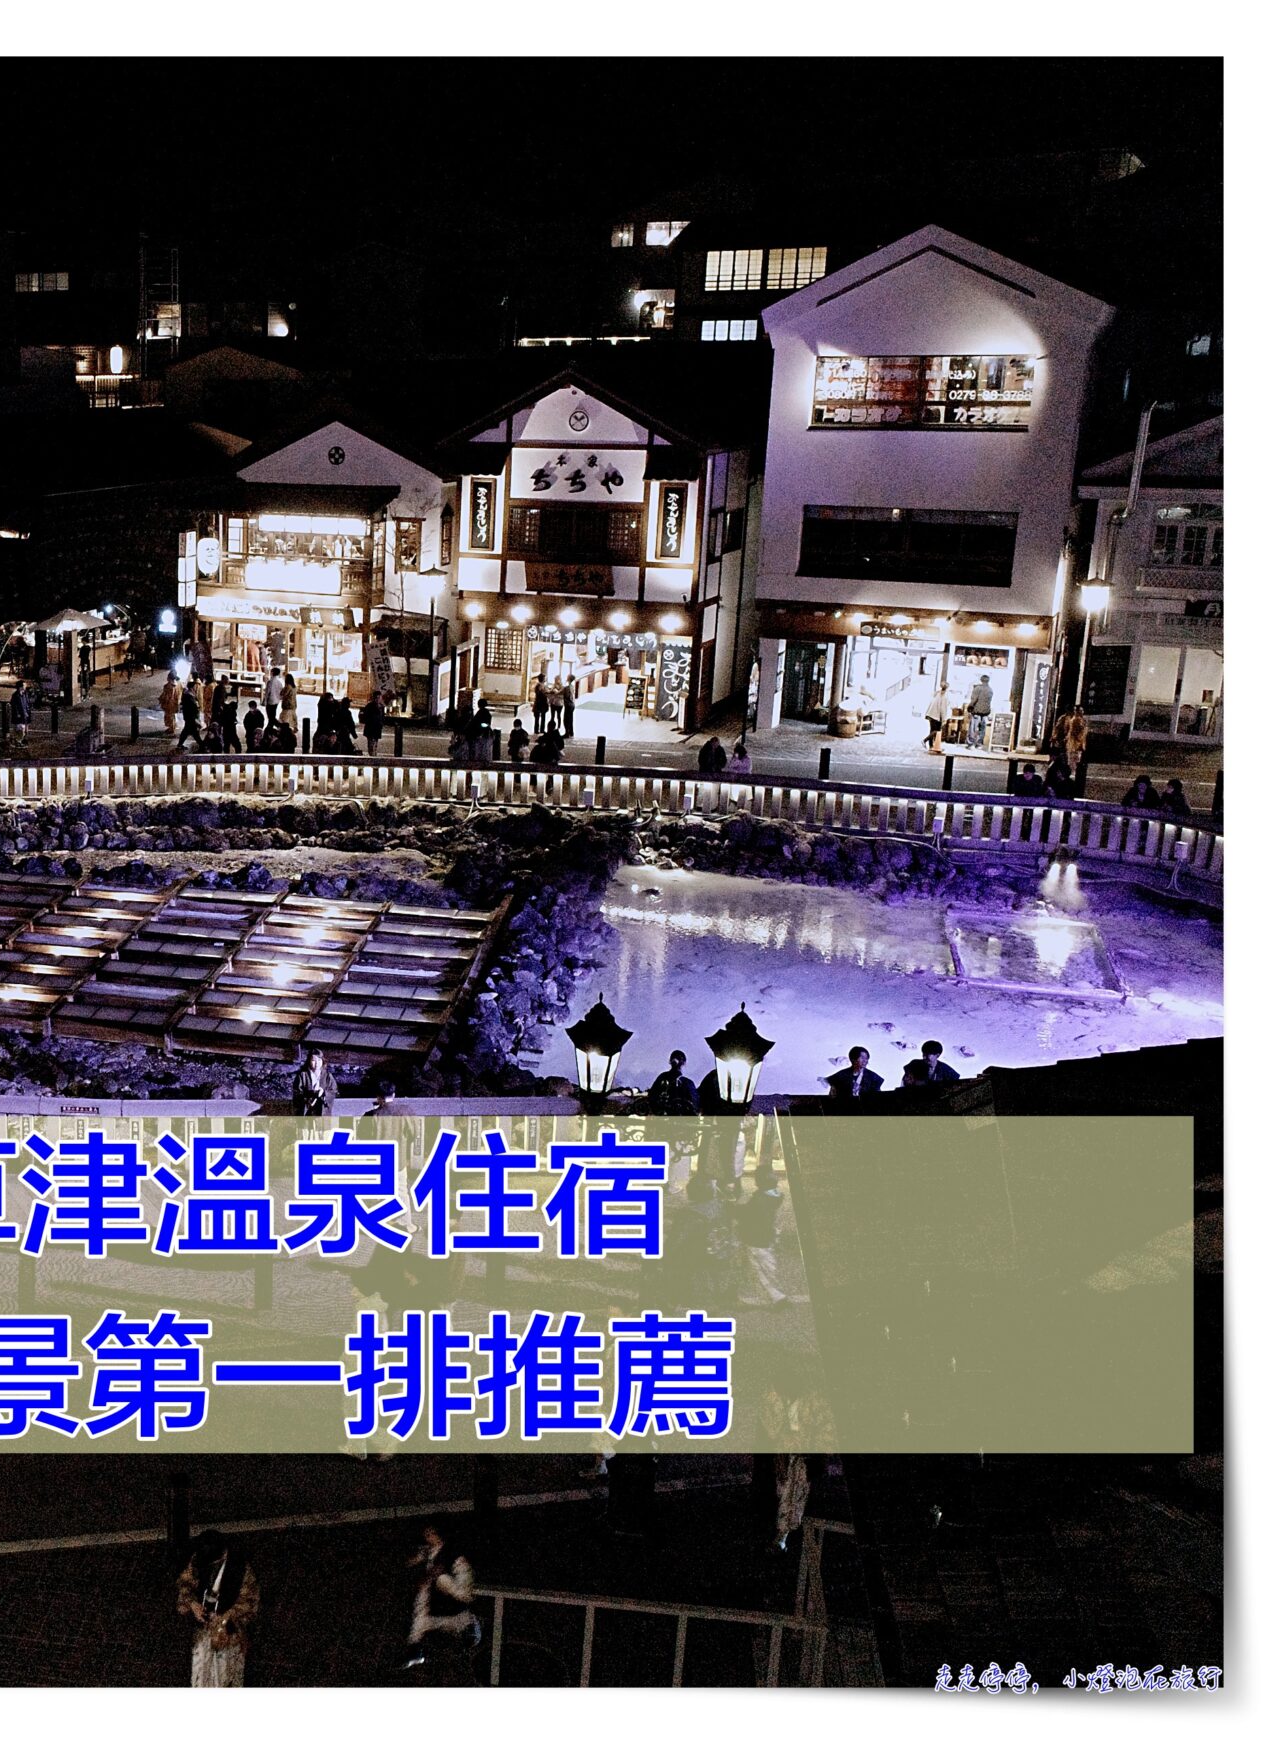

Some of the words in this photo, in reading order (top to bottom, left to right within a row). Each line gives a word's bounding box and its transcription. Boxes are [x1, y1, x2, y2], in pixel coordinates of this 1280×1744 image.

[834, 405, 903, 423] カラオケ
[953, 406, 1011, 424] カラオケ
[530, 467, 624, 495] ちちや
